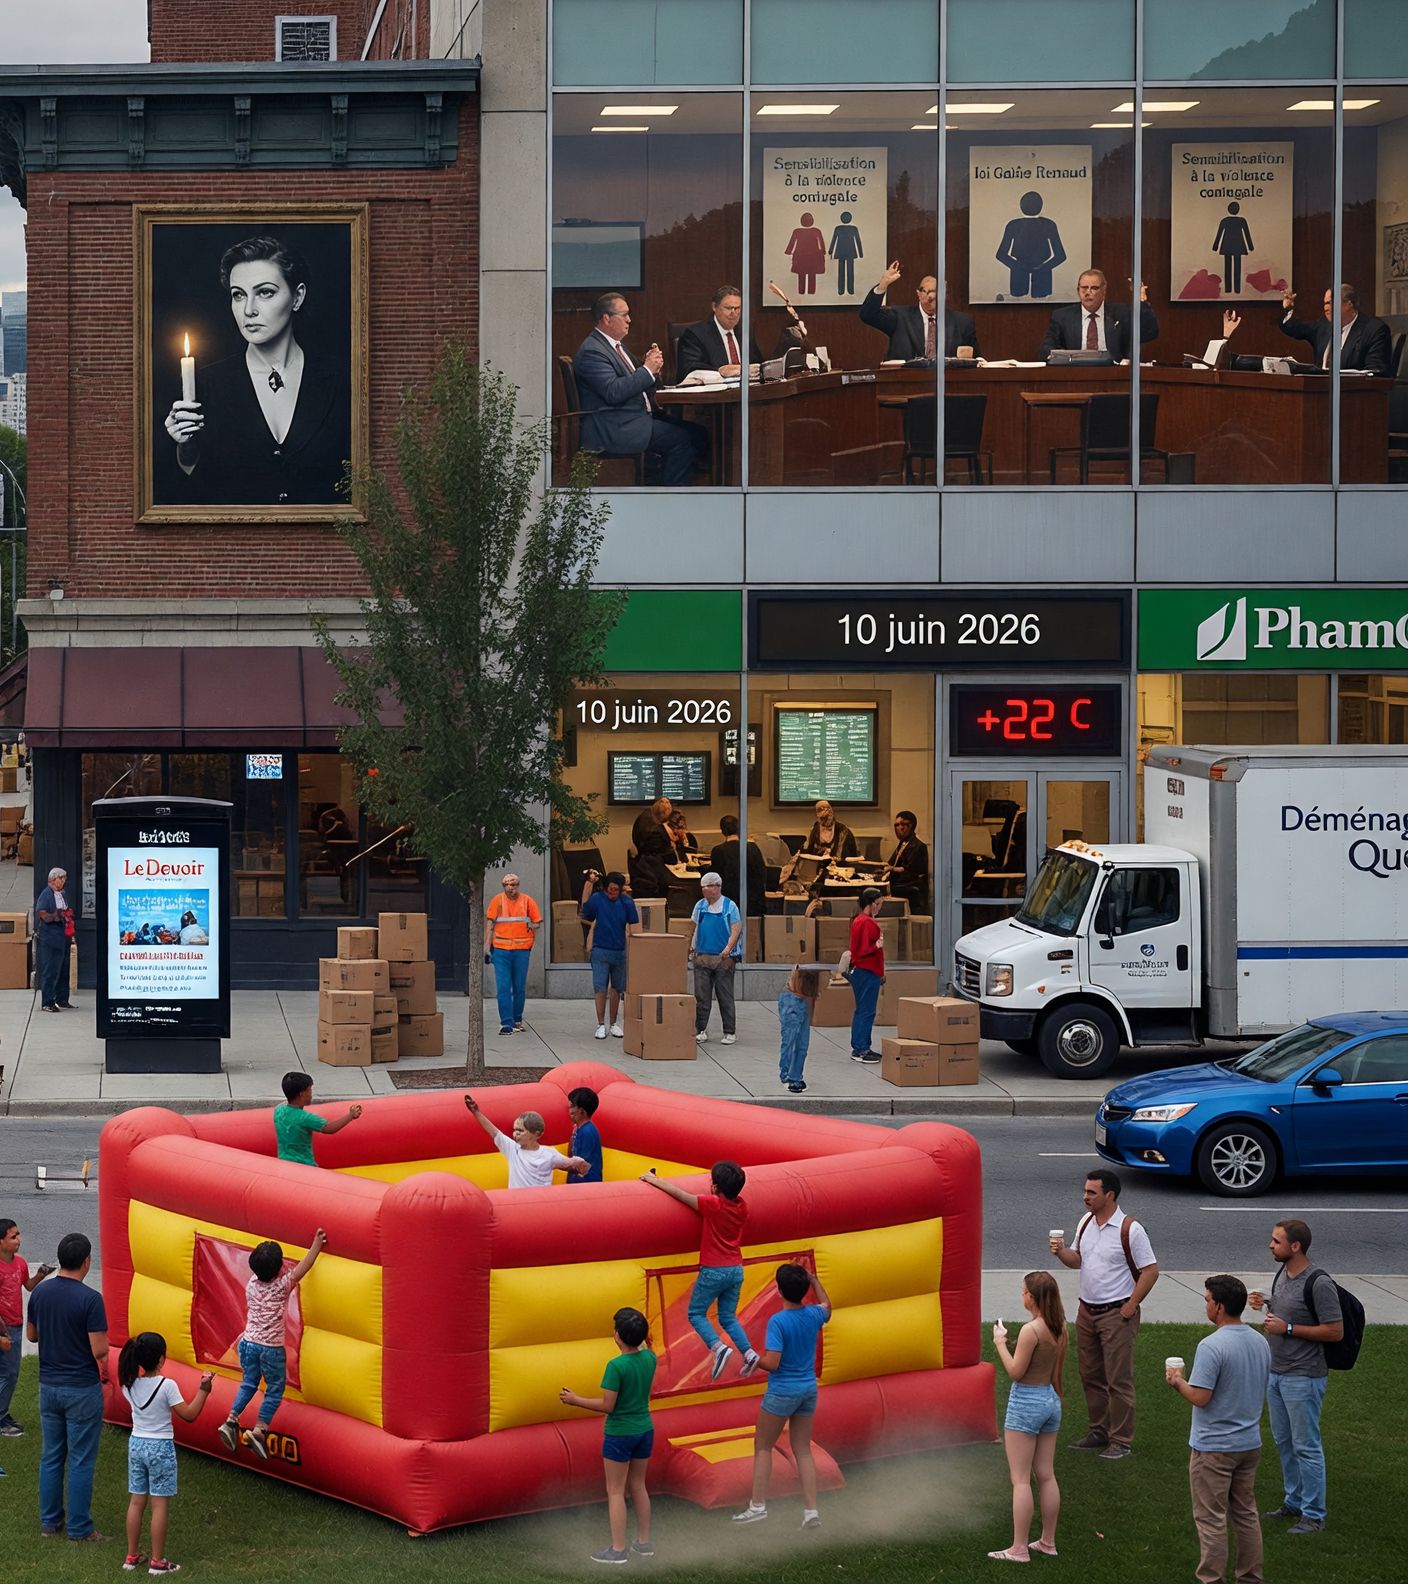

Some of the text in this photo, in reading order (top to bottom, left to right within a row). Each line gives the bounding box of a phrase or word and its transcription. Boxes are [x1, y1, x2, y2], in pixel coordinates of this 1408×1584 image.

[838, 613, 1041, 653] 10 juin 2026
[576, 699, 732, 730] 10 juin 2026
[977, 698, 1092, 740] +22 C
[1348, 838, 1408, 879] Qu
